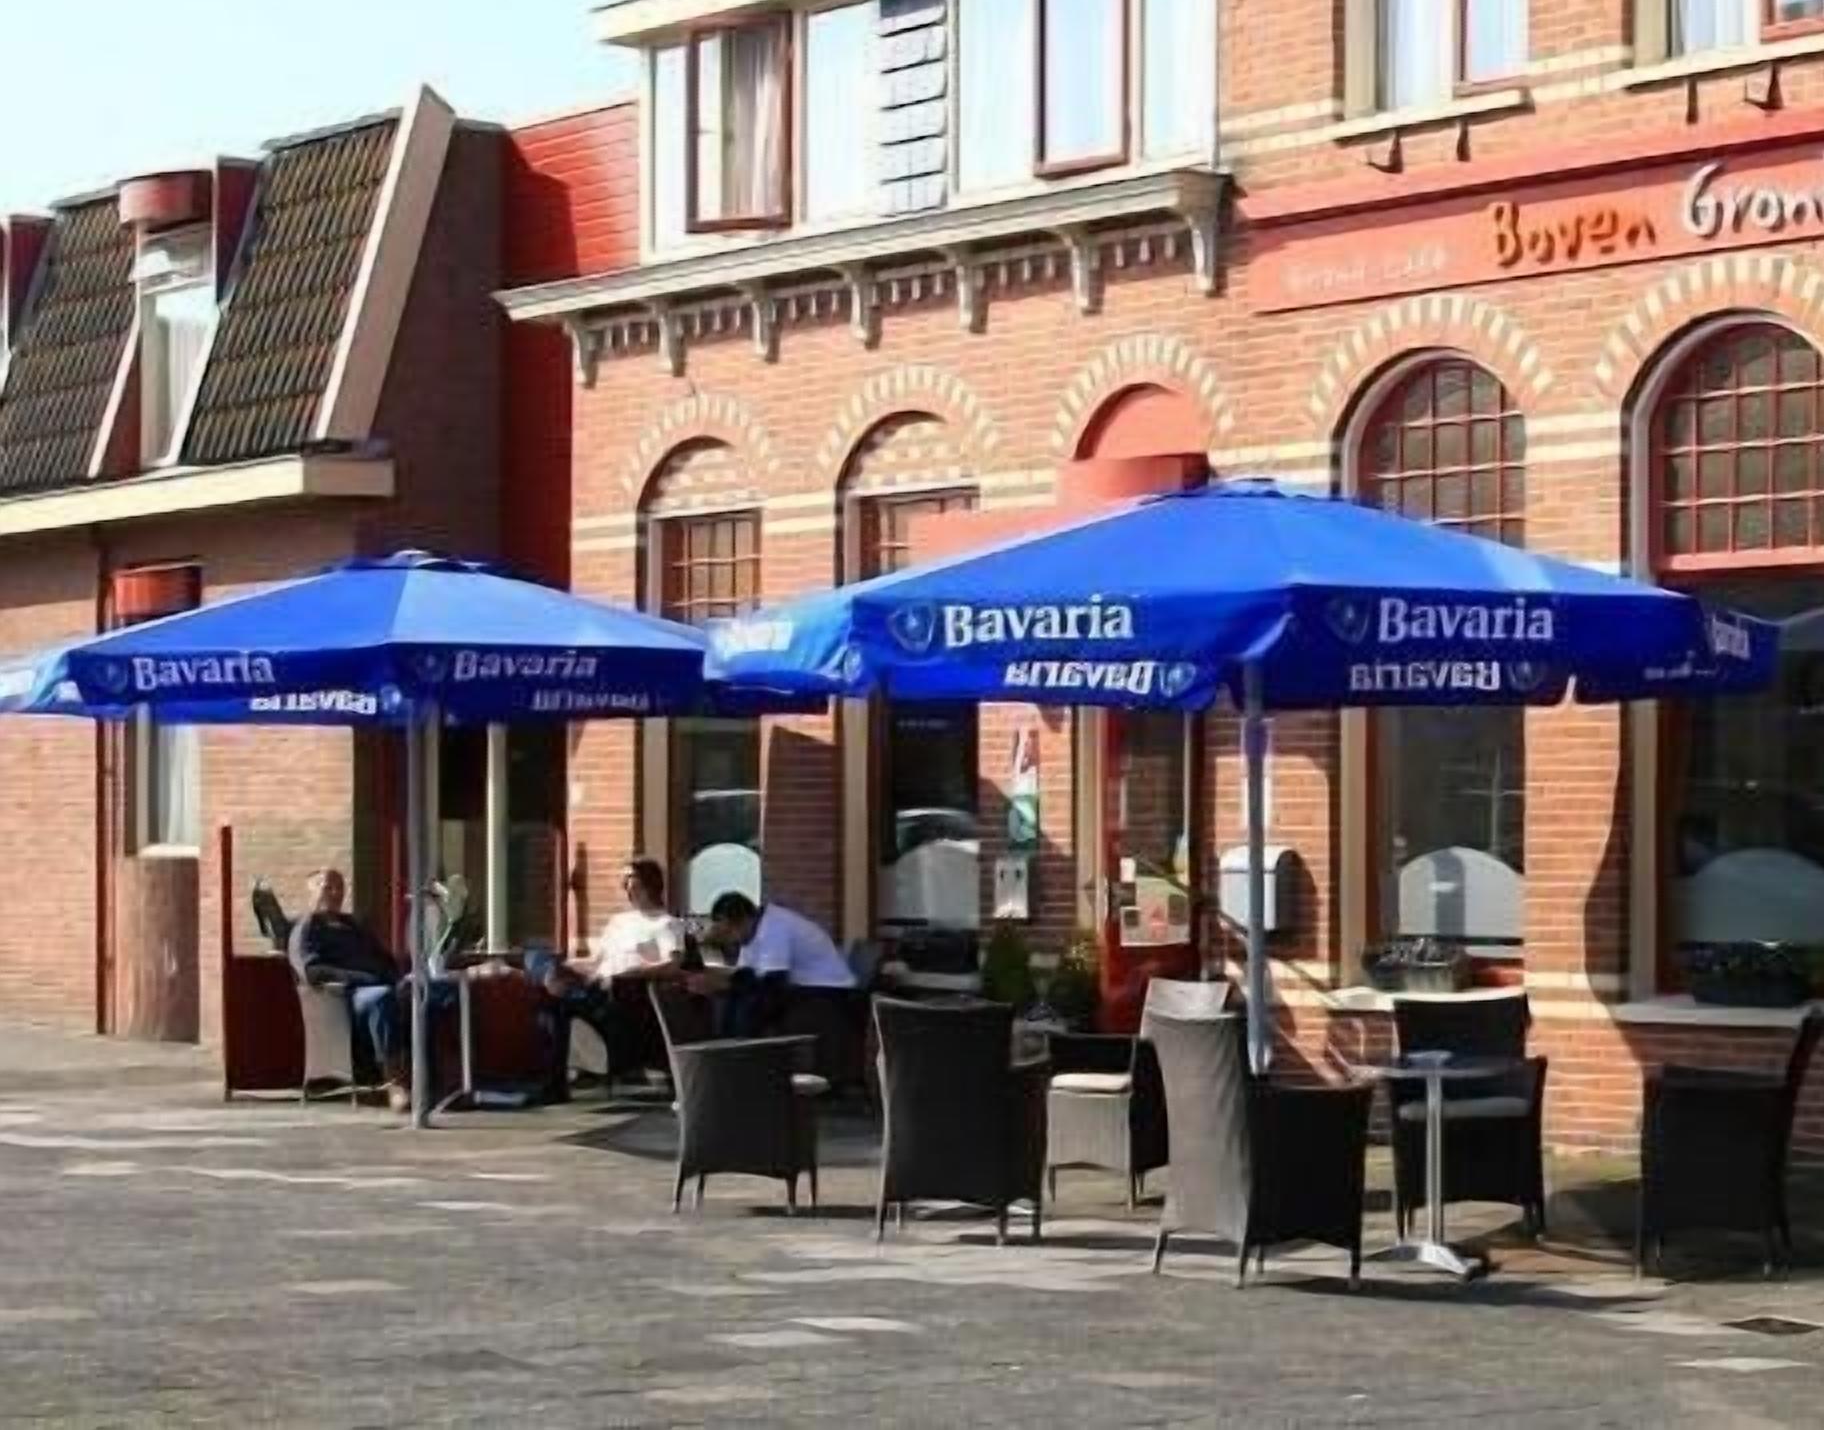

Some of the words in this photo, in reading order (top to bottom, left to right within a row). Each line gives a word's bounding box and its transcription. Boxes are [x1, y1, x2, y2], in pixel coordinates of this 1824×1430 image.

[1486, 200, 1656, 269] Boven
[943, 593, 1136, 649] Bavaria
[1378, 596, 1555, 642] Bavaria
[131, 653, 277, 692] Bavaria
[454, 649, 600, 681] Bavaria
